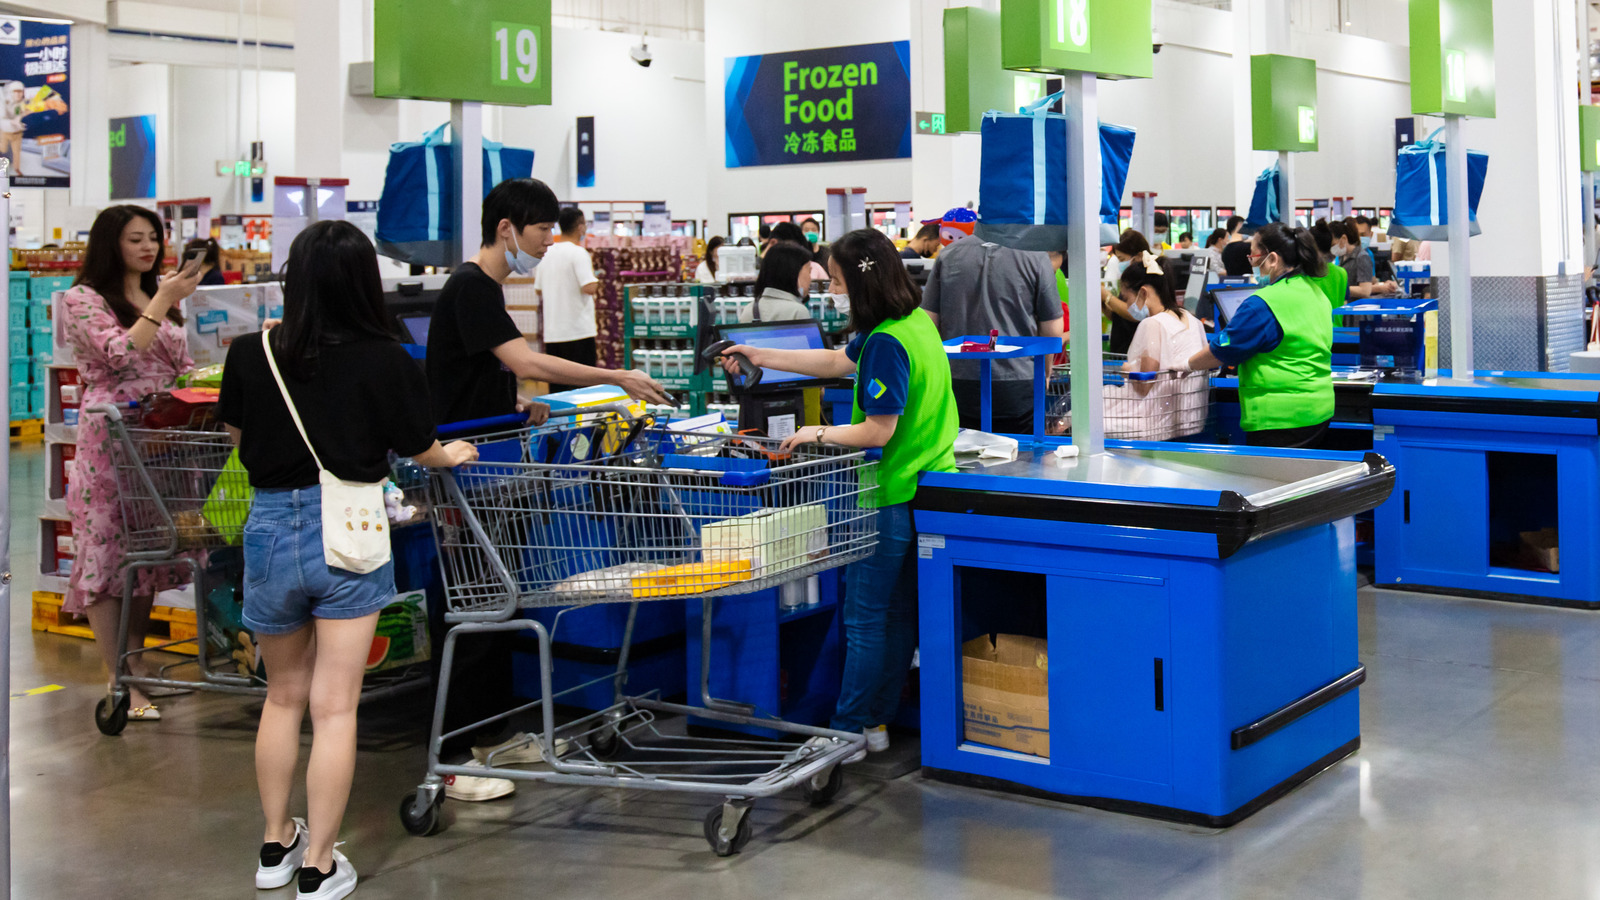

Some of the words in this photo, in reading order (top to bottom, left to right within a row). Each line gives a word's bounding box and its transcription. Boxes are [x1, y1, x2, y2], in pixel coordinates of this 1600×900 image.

[496, 28, 538, 84] 19
[783, 61, 878, 92] Frozen
[784, 88, 853, 124] Food
[784, 128, 856, 154] 冷冻食品
